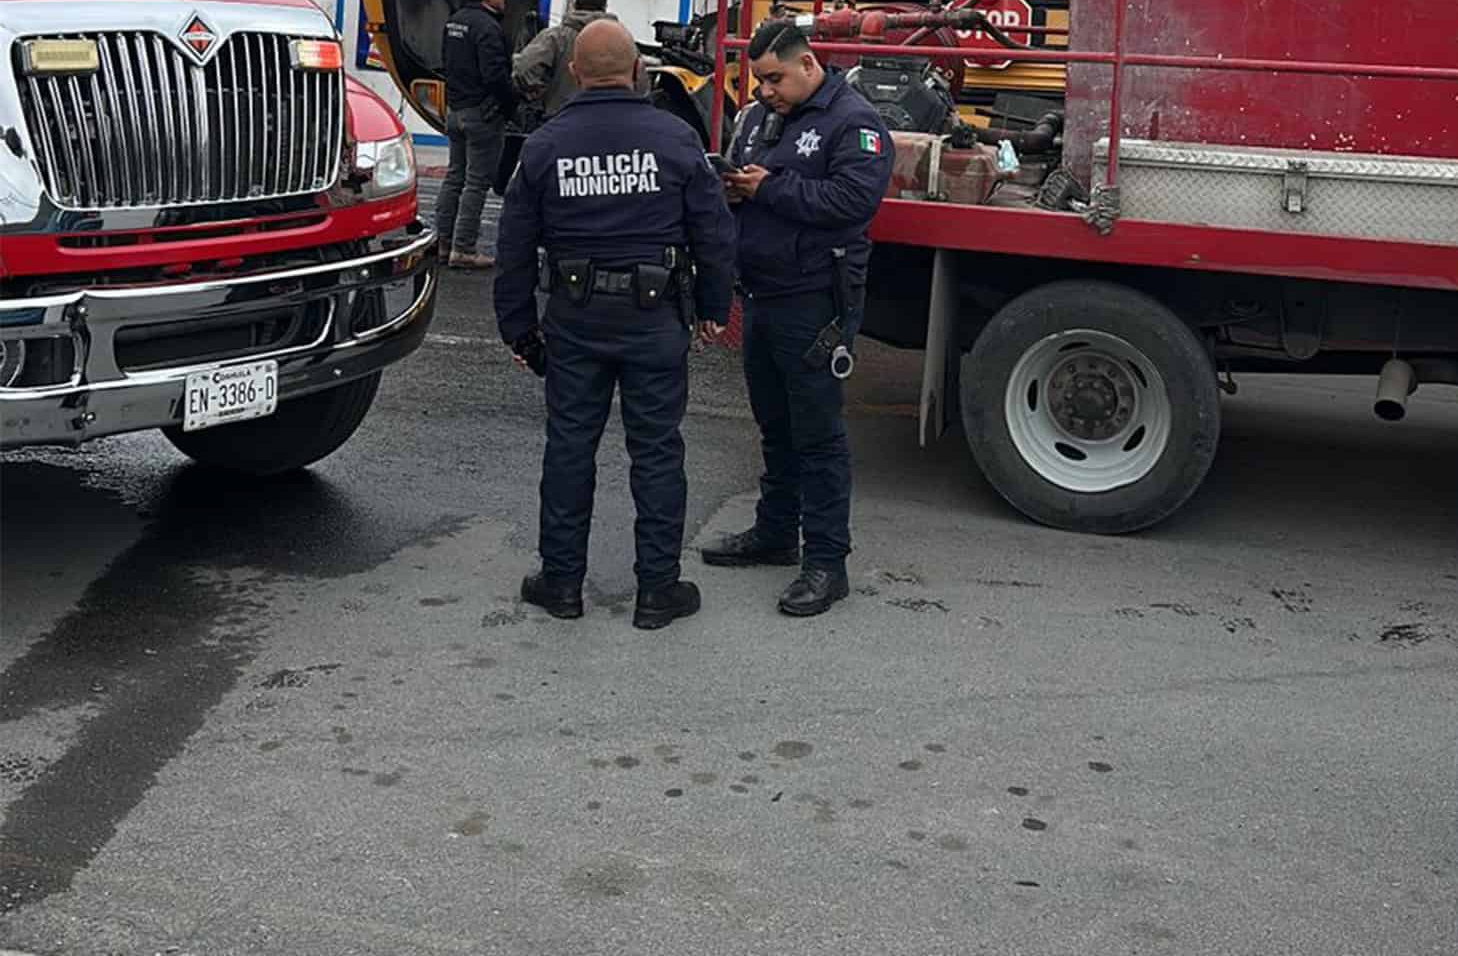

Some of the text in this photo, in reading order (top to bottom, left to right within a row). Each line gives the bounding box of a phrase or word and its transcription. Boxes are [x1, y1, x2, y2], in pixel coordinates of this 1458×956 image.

[956, 9, 1021, 40] OP
[557, 148, 659, 177] POLICÍA
[559, 172, 661, 197] MUNICIPAL
[190, 375, 274, 415] EN-3386-D
